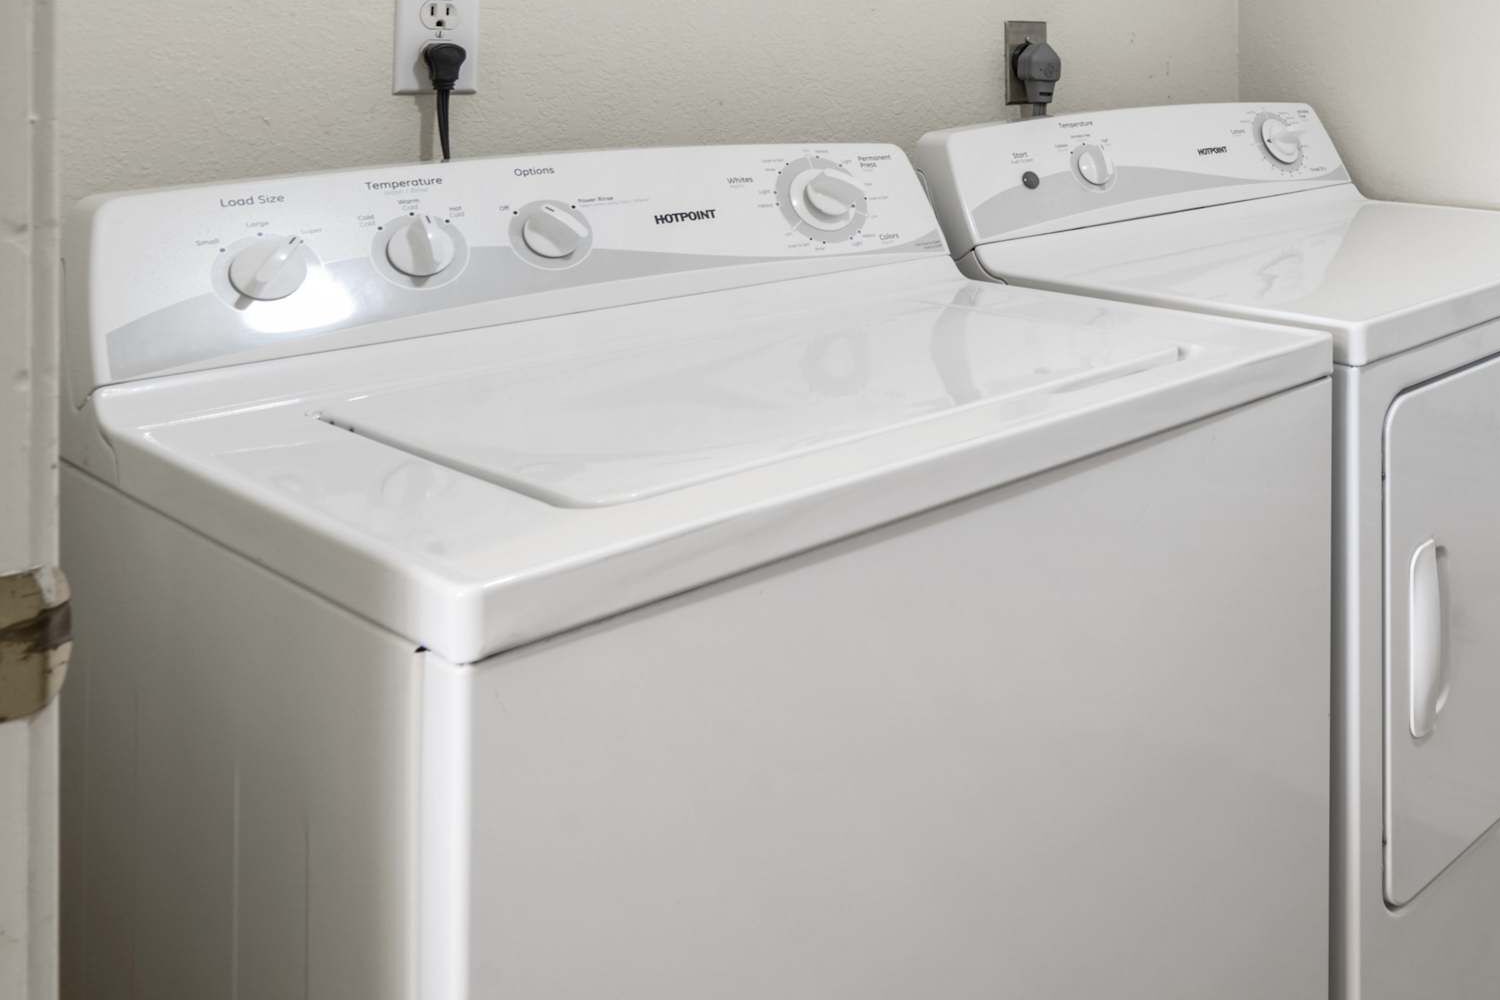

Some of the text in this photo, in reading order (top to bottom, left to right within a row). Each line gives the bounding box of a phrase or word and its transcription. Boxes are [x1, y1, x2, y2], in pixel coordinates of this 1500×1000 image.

[1197, 146, 1228, 156] HOTPOINT
[857, 154, 891, 162] Permanent
[514, 166, 556, 178] Options
[364, 177, 444, 191] Temperature
[727, 176, 755, 184] Whites
[219, 194, 286, 208] Load Size
[654, 209, 717, 225] HOTPOINT
[879, 232, 901, 242] Colors
